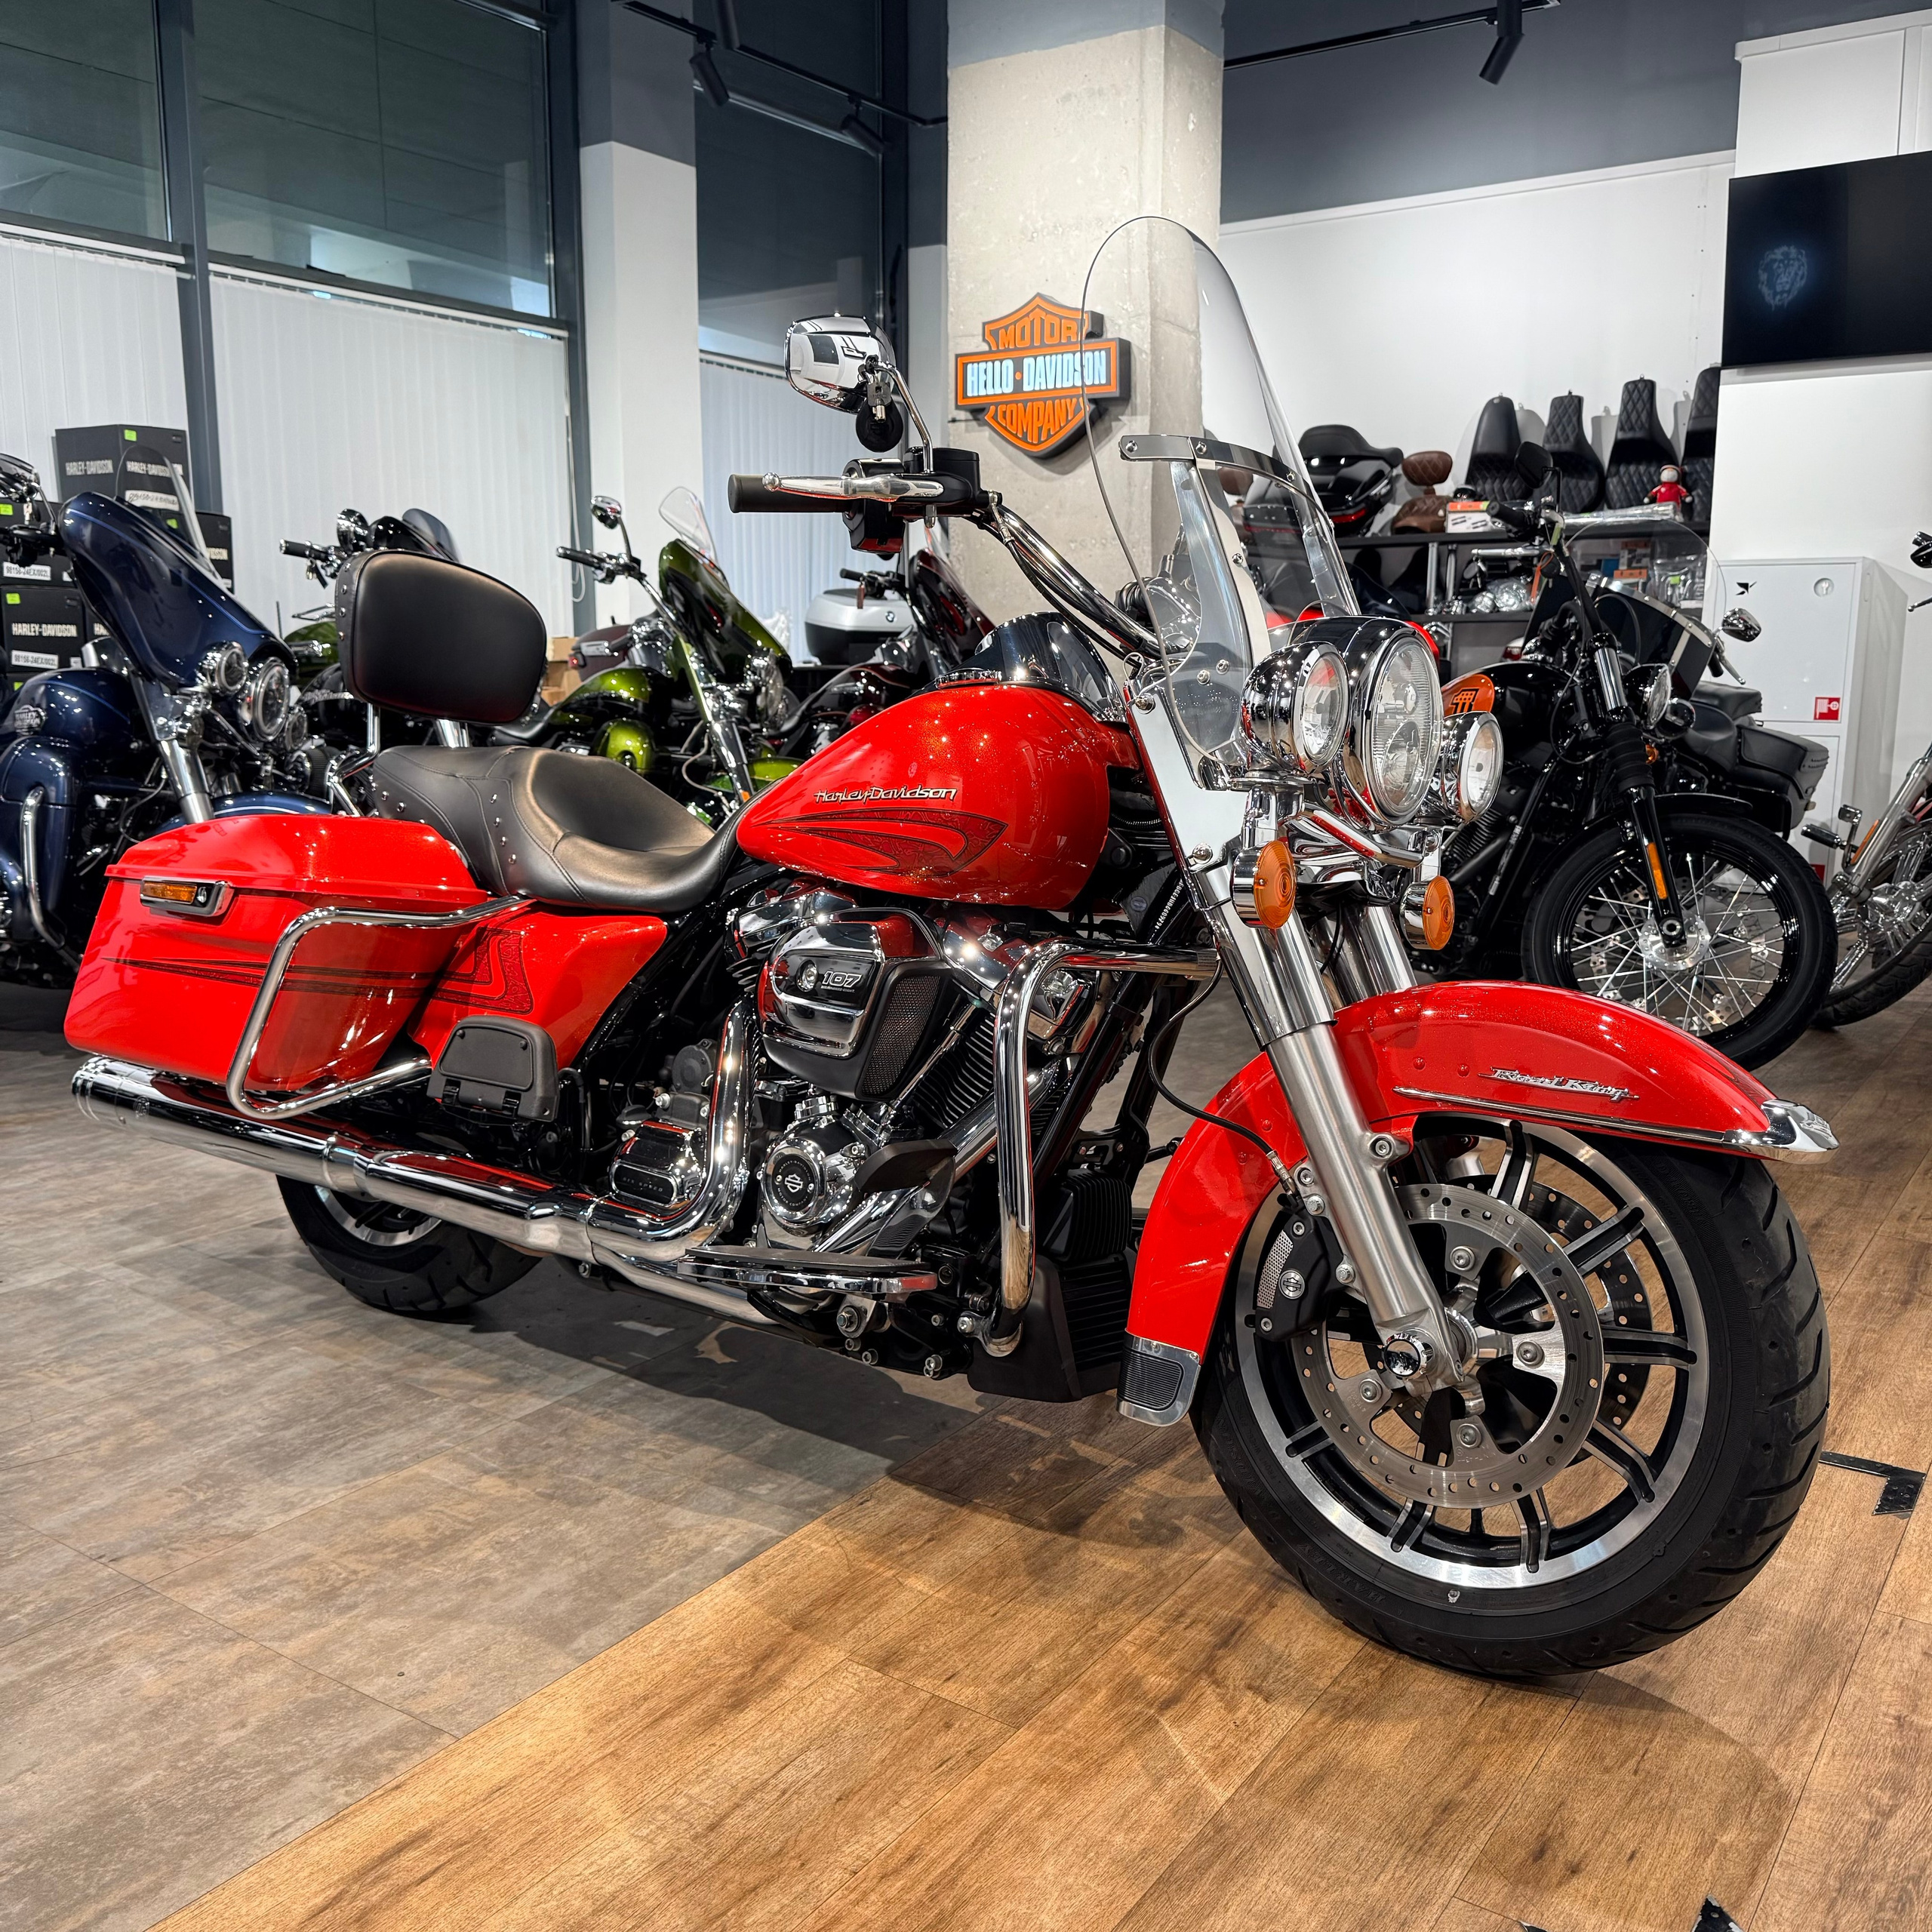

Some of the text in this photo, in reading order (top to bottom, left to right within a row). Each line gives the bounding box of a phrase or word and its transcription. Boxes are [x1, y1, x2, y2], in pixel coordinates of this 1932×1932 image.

[999, 307, 1078, 349] MOTOR
[967, 350, 1106, 397] HELLO DAVIDSON
[998, 398, 1077, 444] COMPANY
[65, 460, 113, 475] HARLEY-DAVIDSON
[11, 623, 78, 637] HARLEY-DAVIDSON
[814, 784, 958, 804] Harley-Davidson
[822, 971, 863, 988] 107
[1488, 1066, 1630, 1103] Road King
